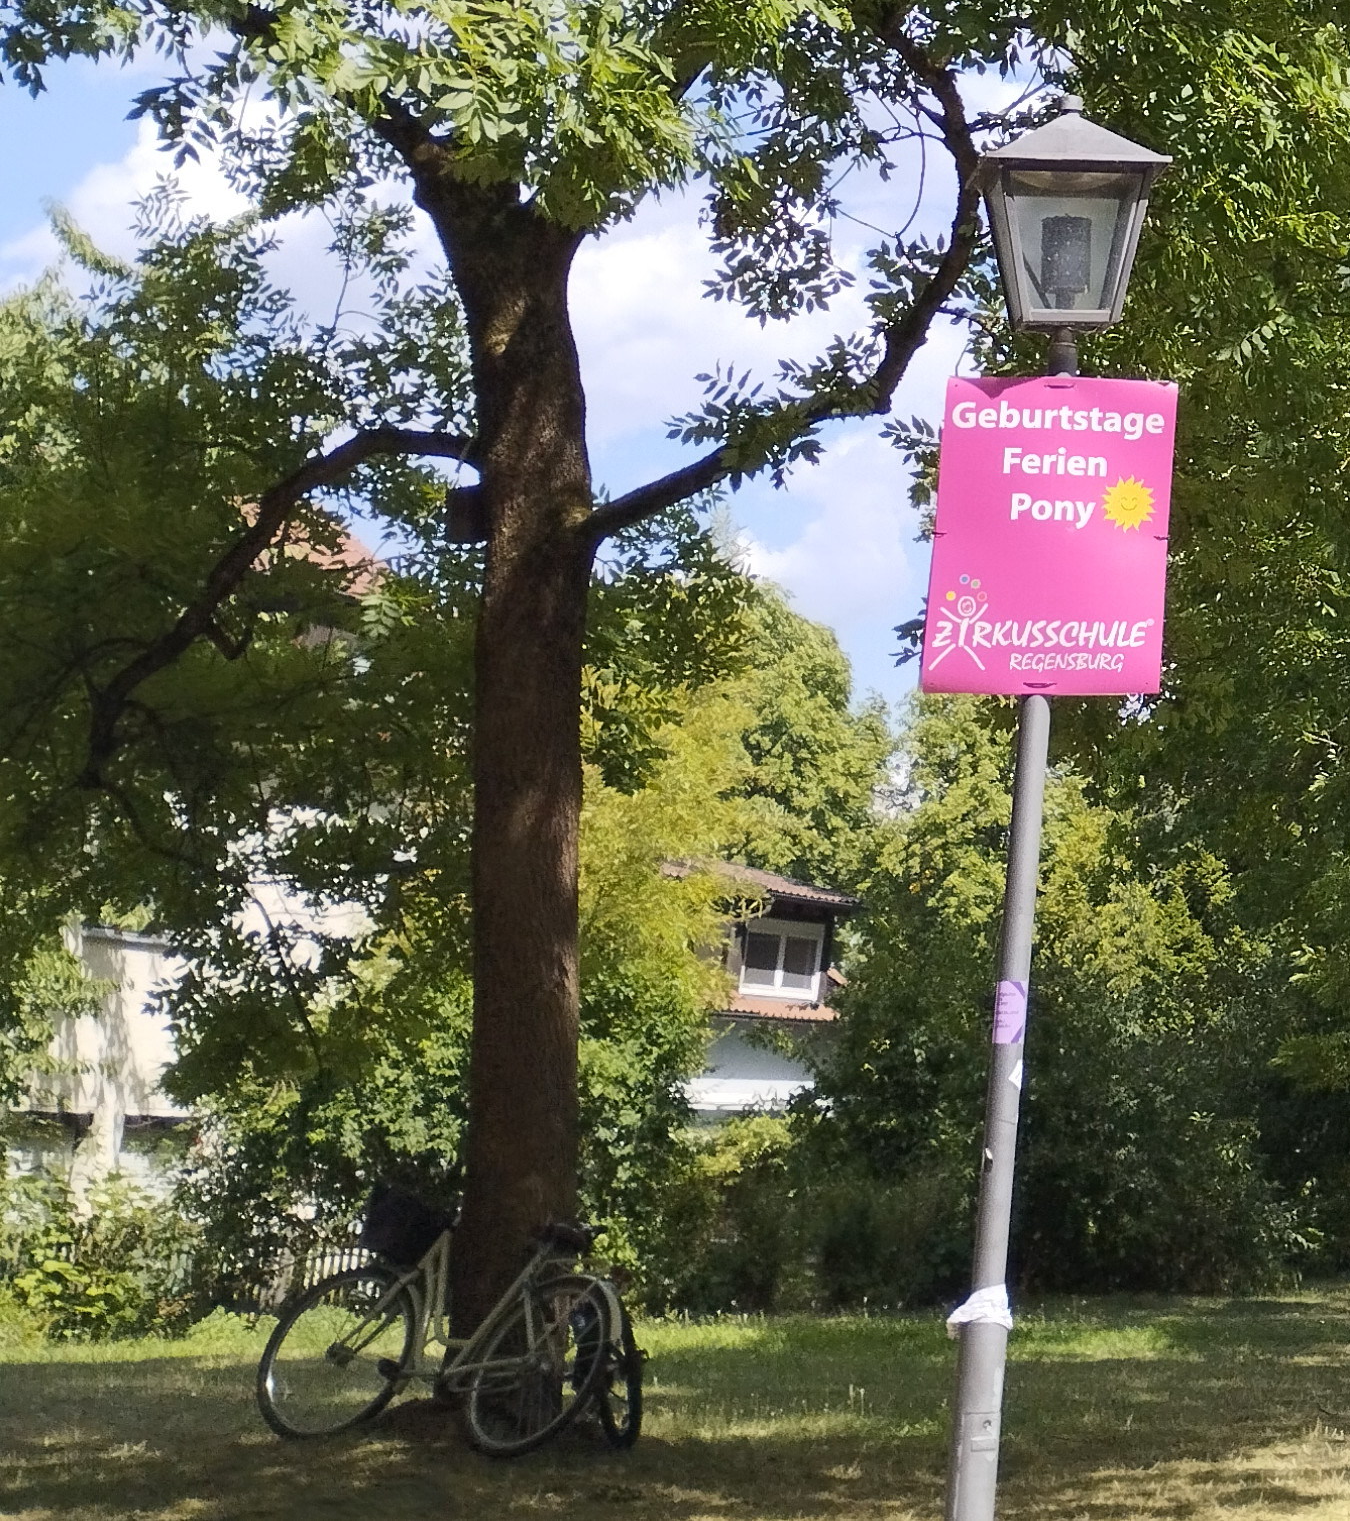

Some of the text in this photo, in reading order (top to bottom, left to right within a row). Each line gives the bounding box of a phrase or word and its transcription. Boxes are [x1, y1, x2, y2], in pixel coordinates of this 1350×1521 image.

[952, 401, 1164, 440] Geburtstage
[1002, 447, 1107, 477] Ferien
[1010, 493, 1095, 529] Pony
[932, 619, 1147, 648] ZIRKUSSCHULE
[1009, 653, 1124, 672] REGENSBURG
